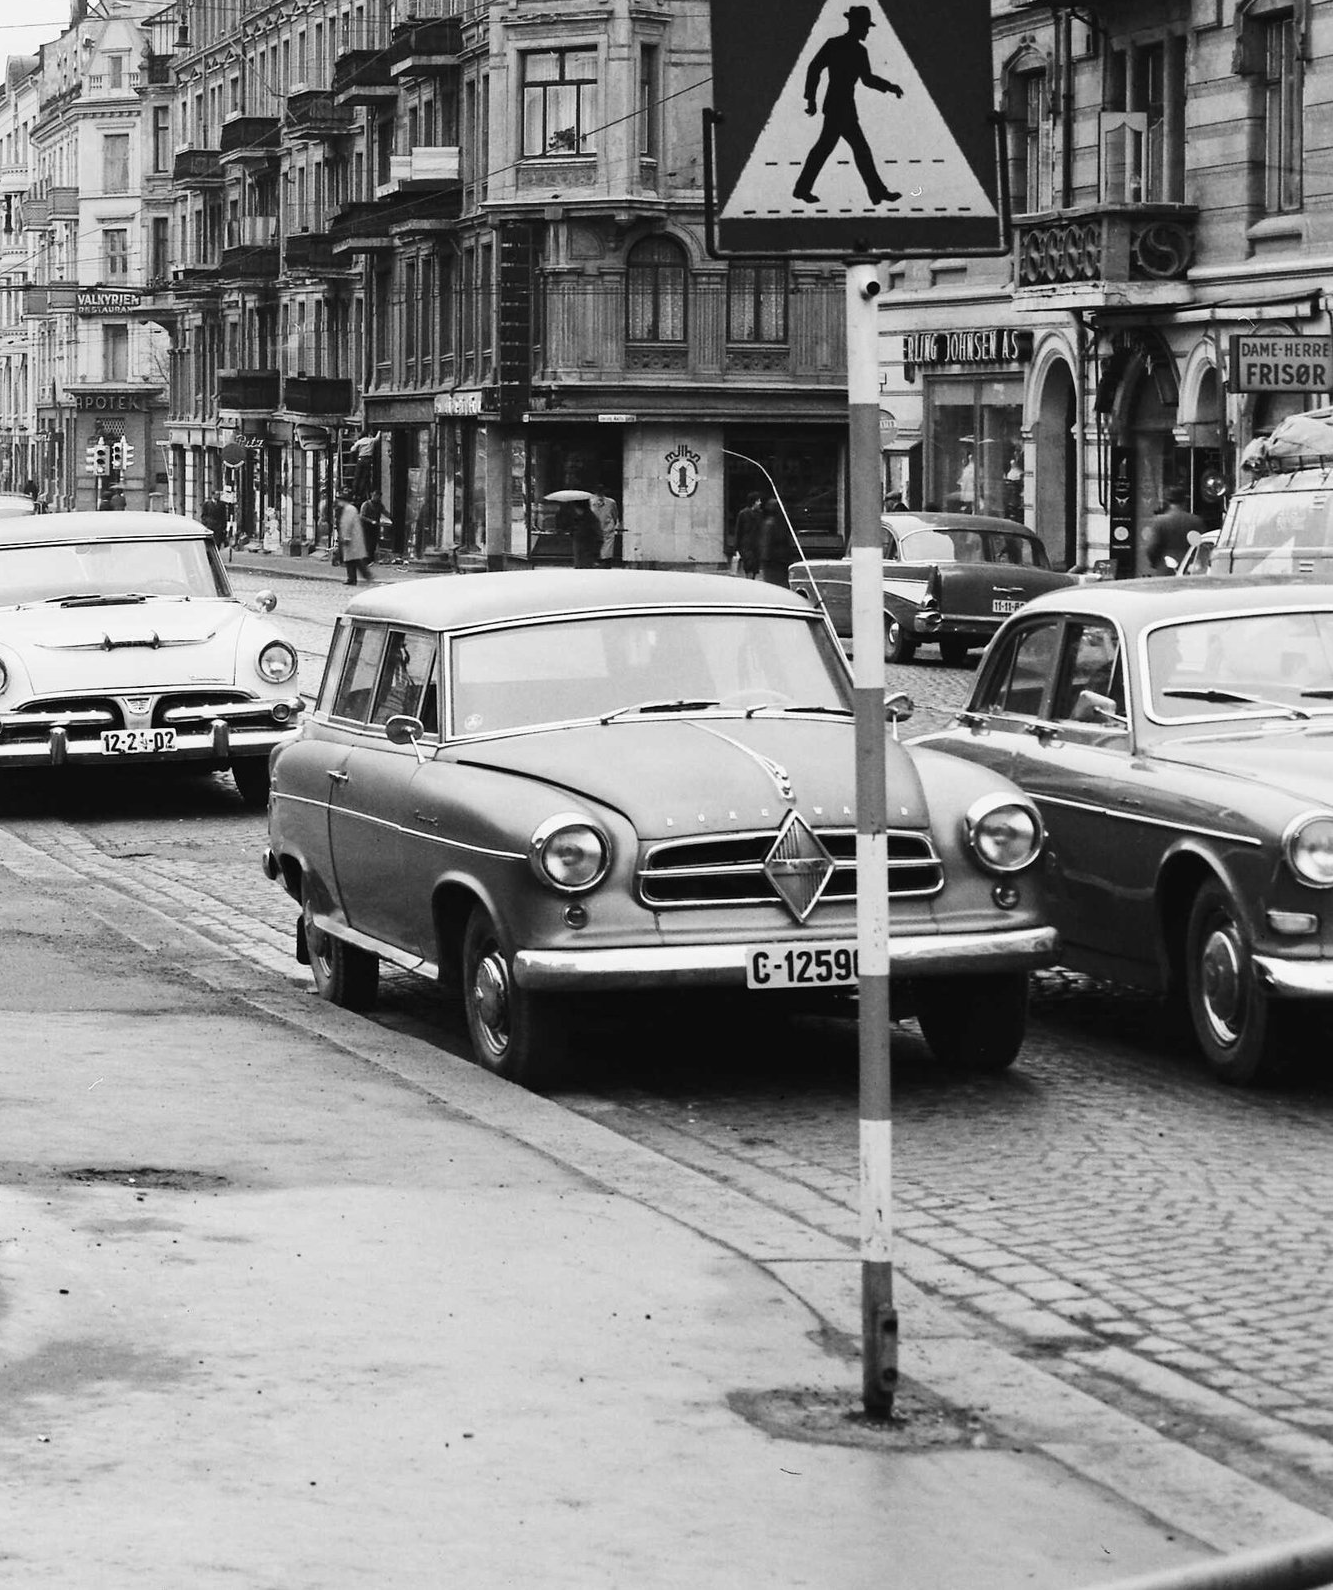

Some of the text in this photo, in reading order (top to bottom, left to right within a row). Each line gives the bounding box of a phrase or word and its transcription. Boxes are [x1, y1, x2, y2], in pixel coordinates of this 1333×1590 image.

[78, 294, 140, 306] VALKYRIEN
[944, 331, 996, 361] JOHNSEN
[1242, 342, 1329, 357] DAME-HERRE
[1247, 363, 1326, 385] FRISØR
[76, 396, 139, 409] APOTEK
[753, 949, 859, 984] C-1259
